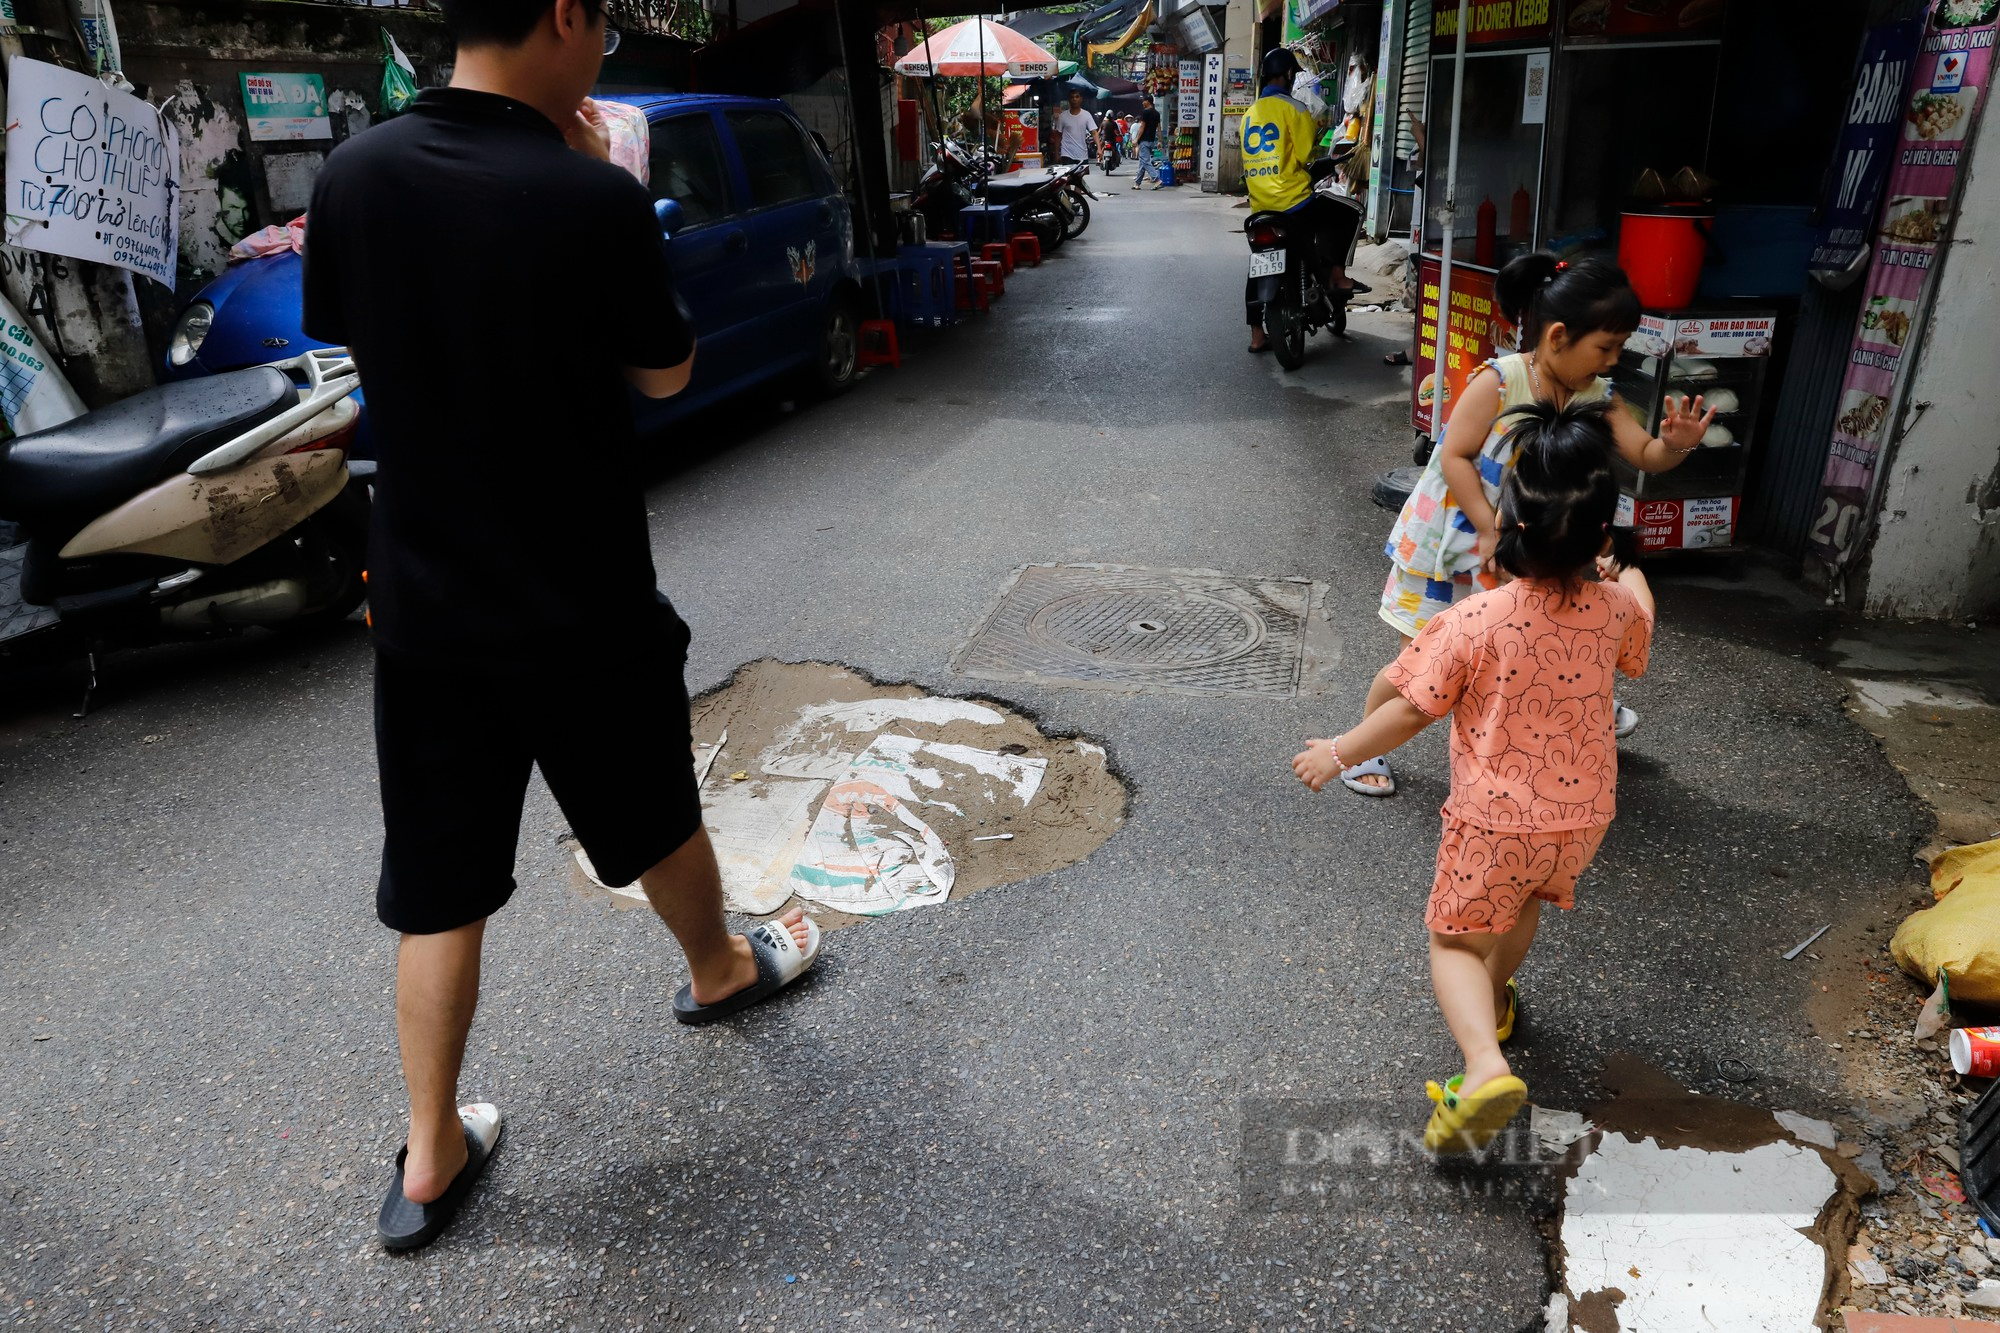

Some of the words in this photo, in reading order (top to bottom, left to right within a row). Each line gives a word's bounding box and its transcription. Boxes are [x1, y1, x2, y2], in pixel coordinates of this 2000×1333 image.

[1434, 4, 1460, 37] BÁNH
[1476, 1, 1512, 32] DONER
[1514, 0, 1549, 28] KEBAB
[1923, 33, 1953, 55] NỘM
[1951, 29, 1970, 50] BÒ
[1970, 27, 1996, 48] KHÔ
[908, 64, 929, 72] ENEOS
[1025, 64, 1048, 72] ENEOS
[1180, 77, 1199, 87] THẺ
[1847, 49, 1907, 125] BÁNH
[40, 90, 97, 141] CÓ
[1243, 116, 1280, 155] be
[34, 135, 97, 182] CHO
[1836, 137, 1875, 210] MỲ
[1251, 261, 1284, 276] 513.59
[1423, 282, 1440, 301] BÁNH
[1451, 290, 1471, 310] DONER
[1472, 296, 1492, 316] KEBAB
[1422, 301, 1439, 321] BÁNH
[1421, 321, 1437, 341] BÁNH
[1709, 320, 1729, 331] BÁNH
[1730, 321, 1744, 330] BAO
[1745, 320, 1769, 330] MILAN
[1420, 341, 1436, 361] BÁNH
[1658, 526, 1672, 535] BAO
[1809, 496, 1861, 551] 20
[1643, 537, 1666, 546] MILAN
